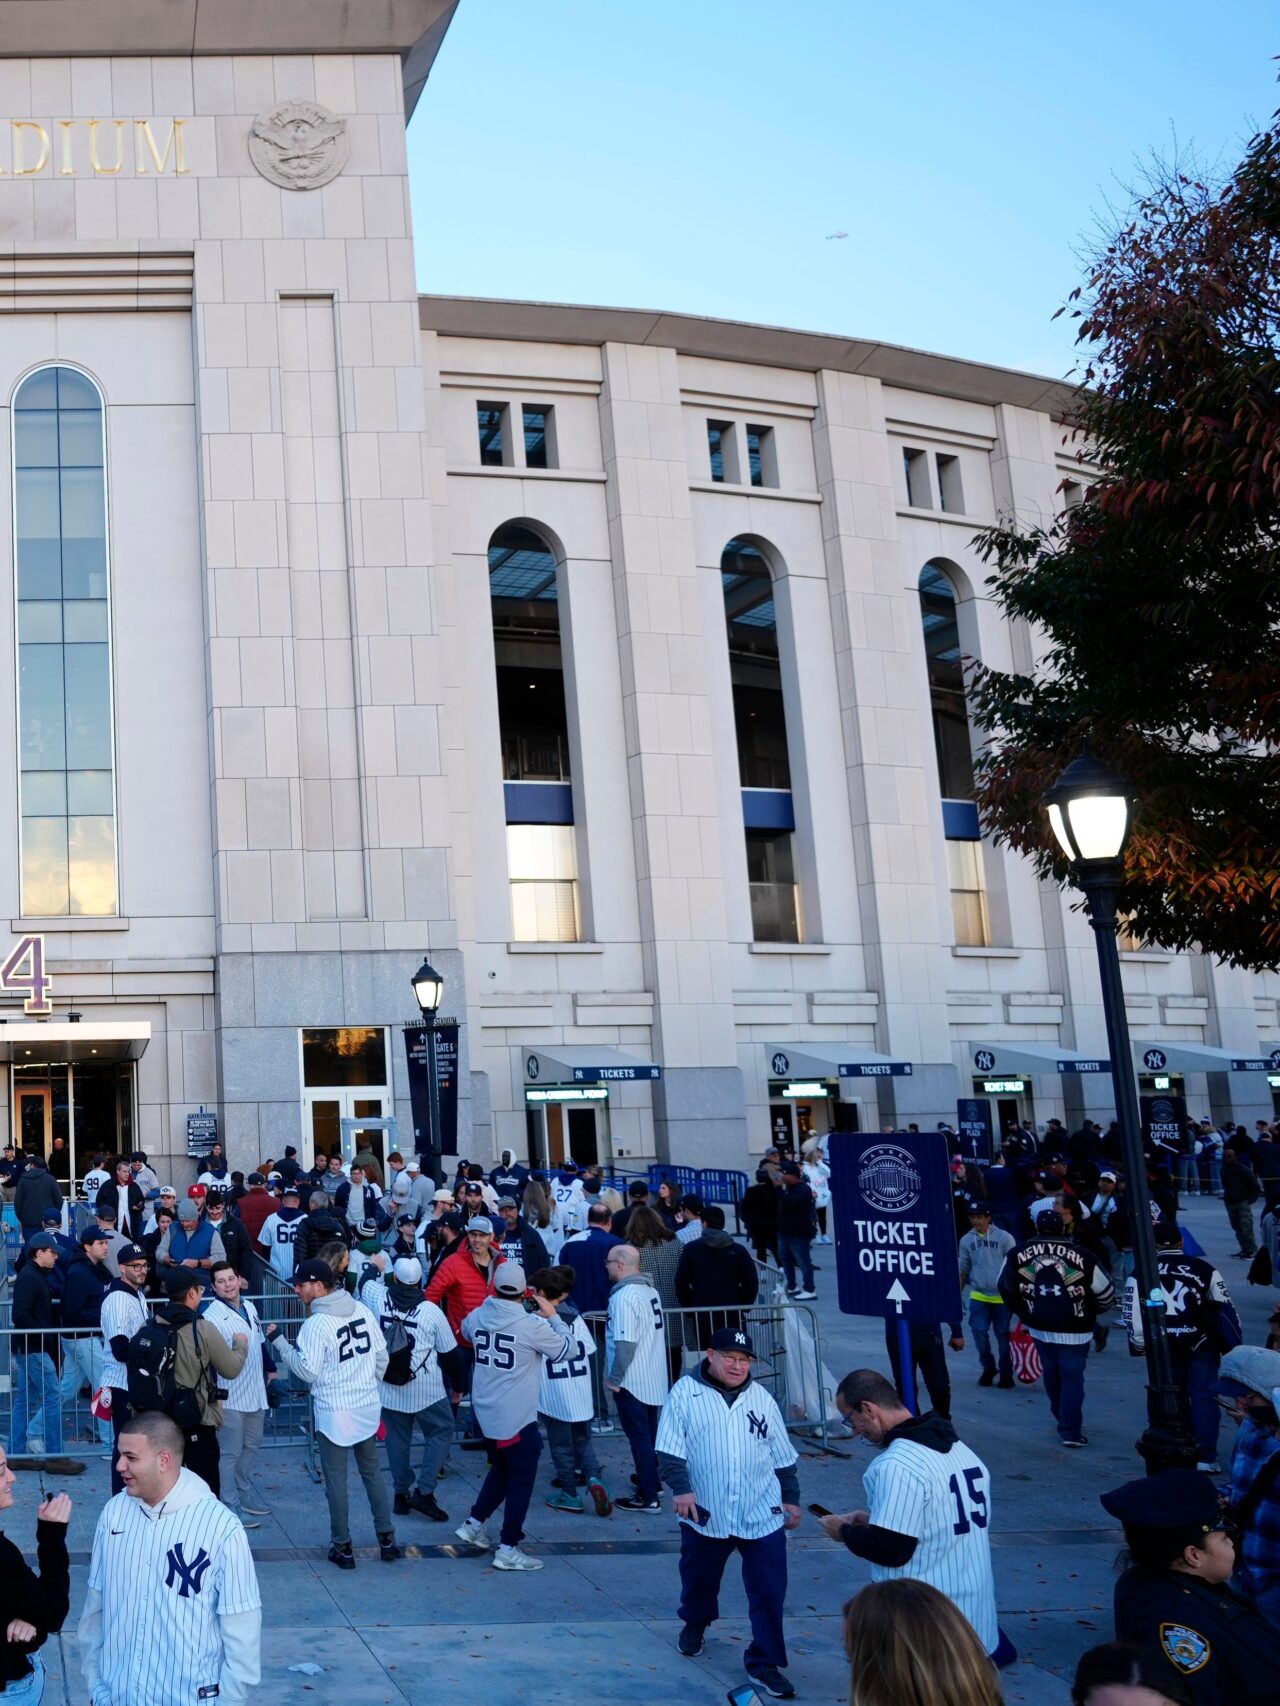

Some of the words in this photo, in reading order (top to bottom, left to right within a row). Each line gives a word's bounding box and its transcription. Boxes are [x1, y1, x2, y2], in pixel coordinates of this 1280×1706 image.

[436, 1043, 449, 1052] GATE
[599, 1069, 635, 1078] TICKETS
[860, 1066, 891, 1074] TICKETS
[1075, 1062, 1100, 1071] TICKETS
[1245, 1062, 1265, 1070] TICKETS
[1150, 1131, 1180, 1139] OFFICE
[863, 1149, 911, 1165] YANKEE
[86, 1178, 100, 1190] 99
[556, 1189, 572, 1202] 27
[866, 1190, 914, 1208] STADIUM
[854, 1220, 928, 1246] TICKET
[859, 1248, 935, 1275] OFFICE
[1017, 1243, 1045, 1264] NEW
[1047, 1243, 1085, 1270] YORK
[650, 1298, 664, 1329] 5
[336, 1318, 371, 1363] 25
[735, 1332, 746, 1345] NY
[474, 1330, 516, 1370] 25
[746, 1410, 768, 1440] NY
[949, 1466, 988, 1536] 15
[164, 1543, 211, 1598] NY
